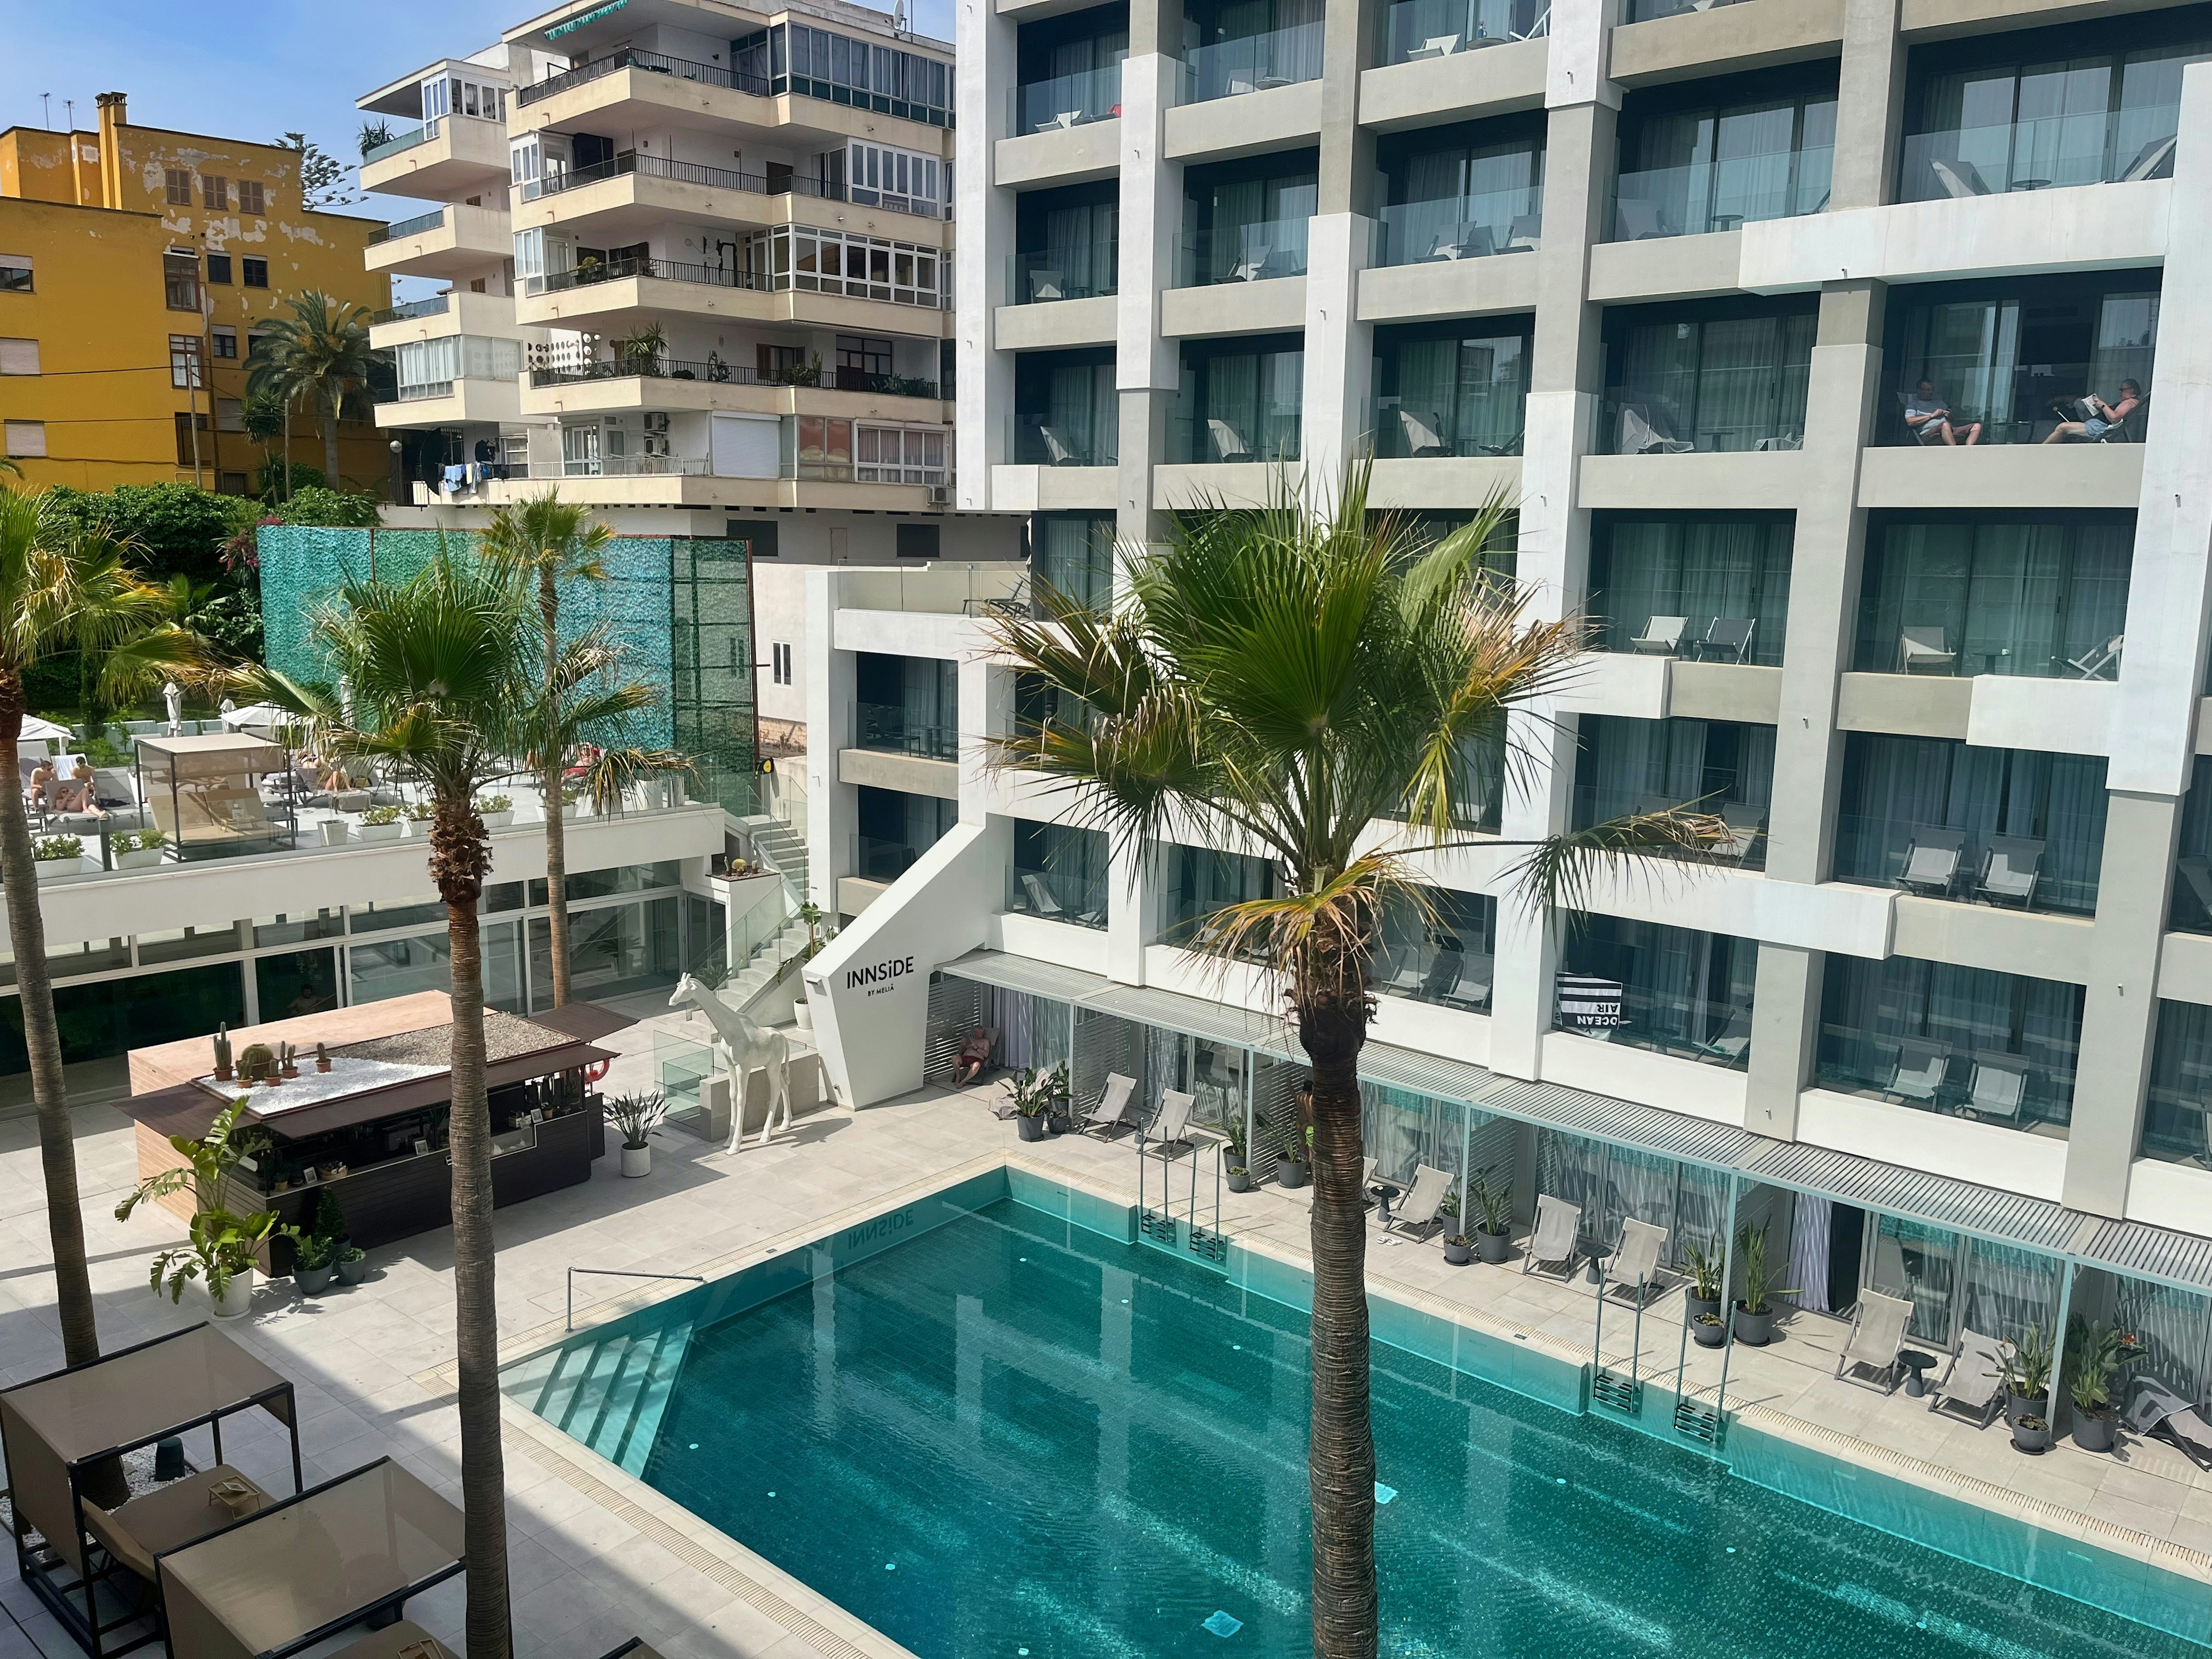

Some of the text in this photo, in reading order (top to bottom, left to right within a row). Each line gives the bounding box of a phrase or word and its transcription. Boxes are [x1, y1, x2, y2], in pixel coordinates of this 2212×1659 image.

[847, 956, 914, 989] INNSiDE
[1596, 1004, 1618, 1013] AIR
[1577, 1016, 1618, 1025] OCEAN
